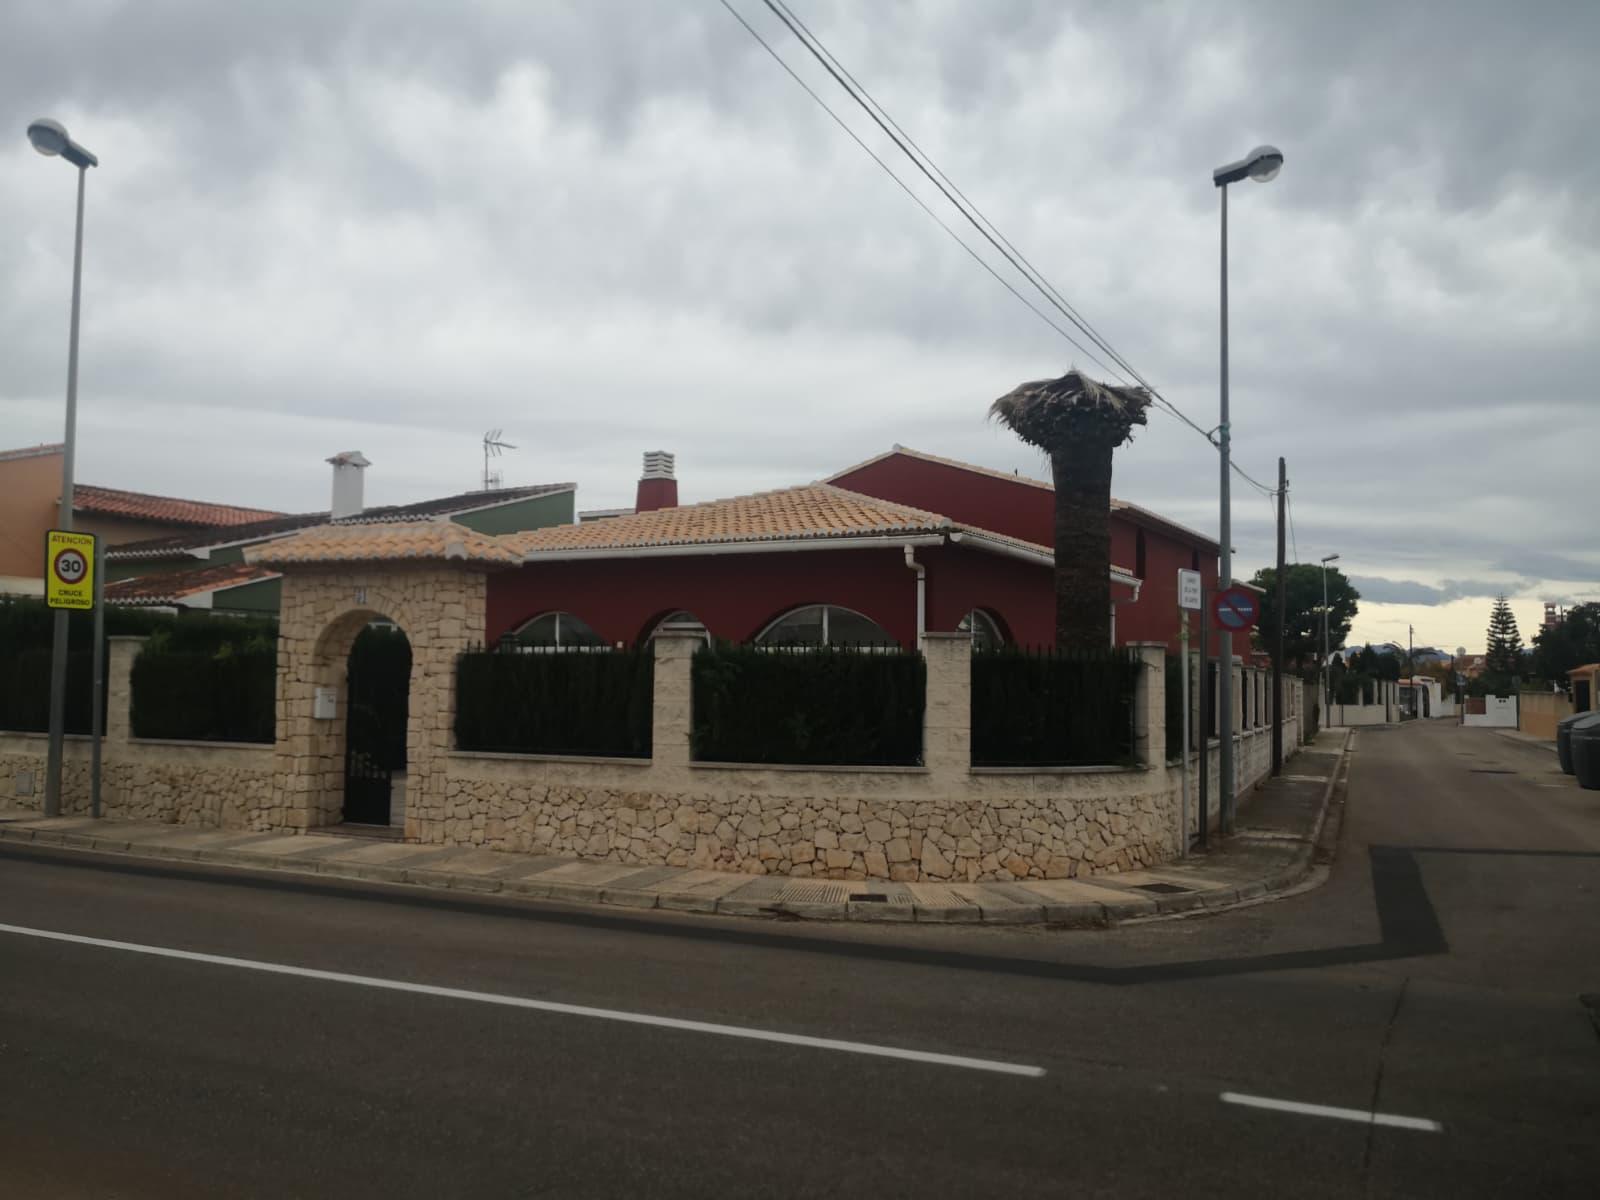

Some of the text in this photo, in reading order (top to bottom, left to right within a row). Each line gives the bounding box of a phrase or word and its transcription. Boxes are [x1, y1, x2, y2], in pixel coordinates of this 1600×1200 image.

[61, 559, 81, 573] 30
[58, 589, 83, 597] CRUCE
[50, 597, 90, 606] PELIGROSO
